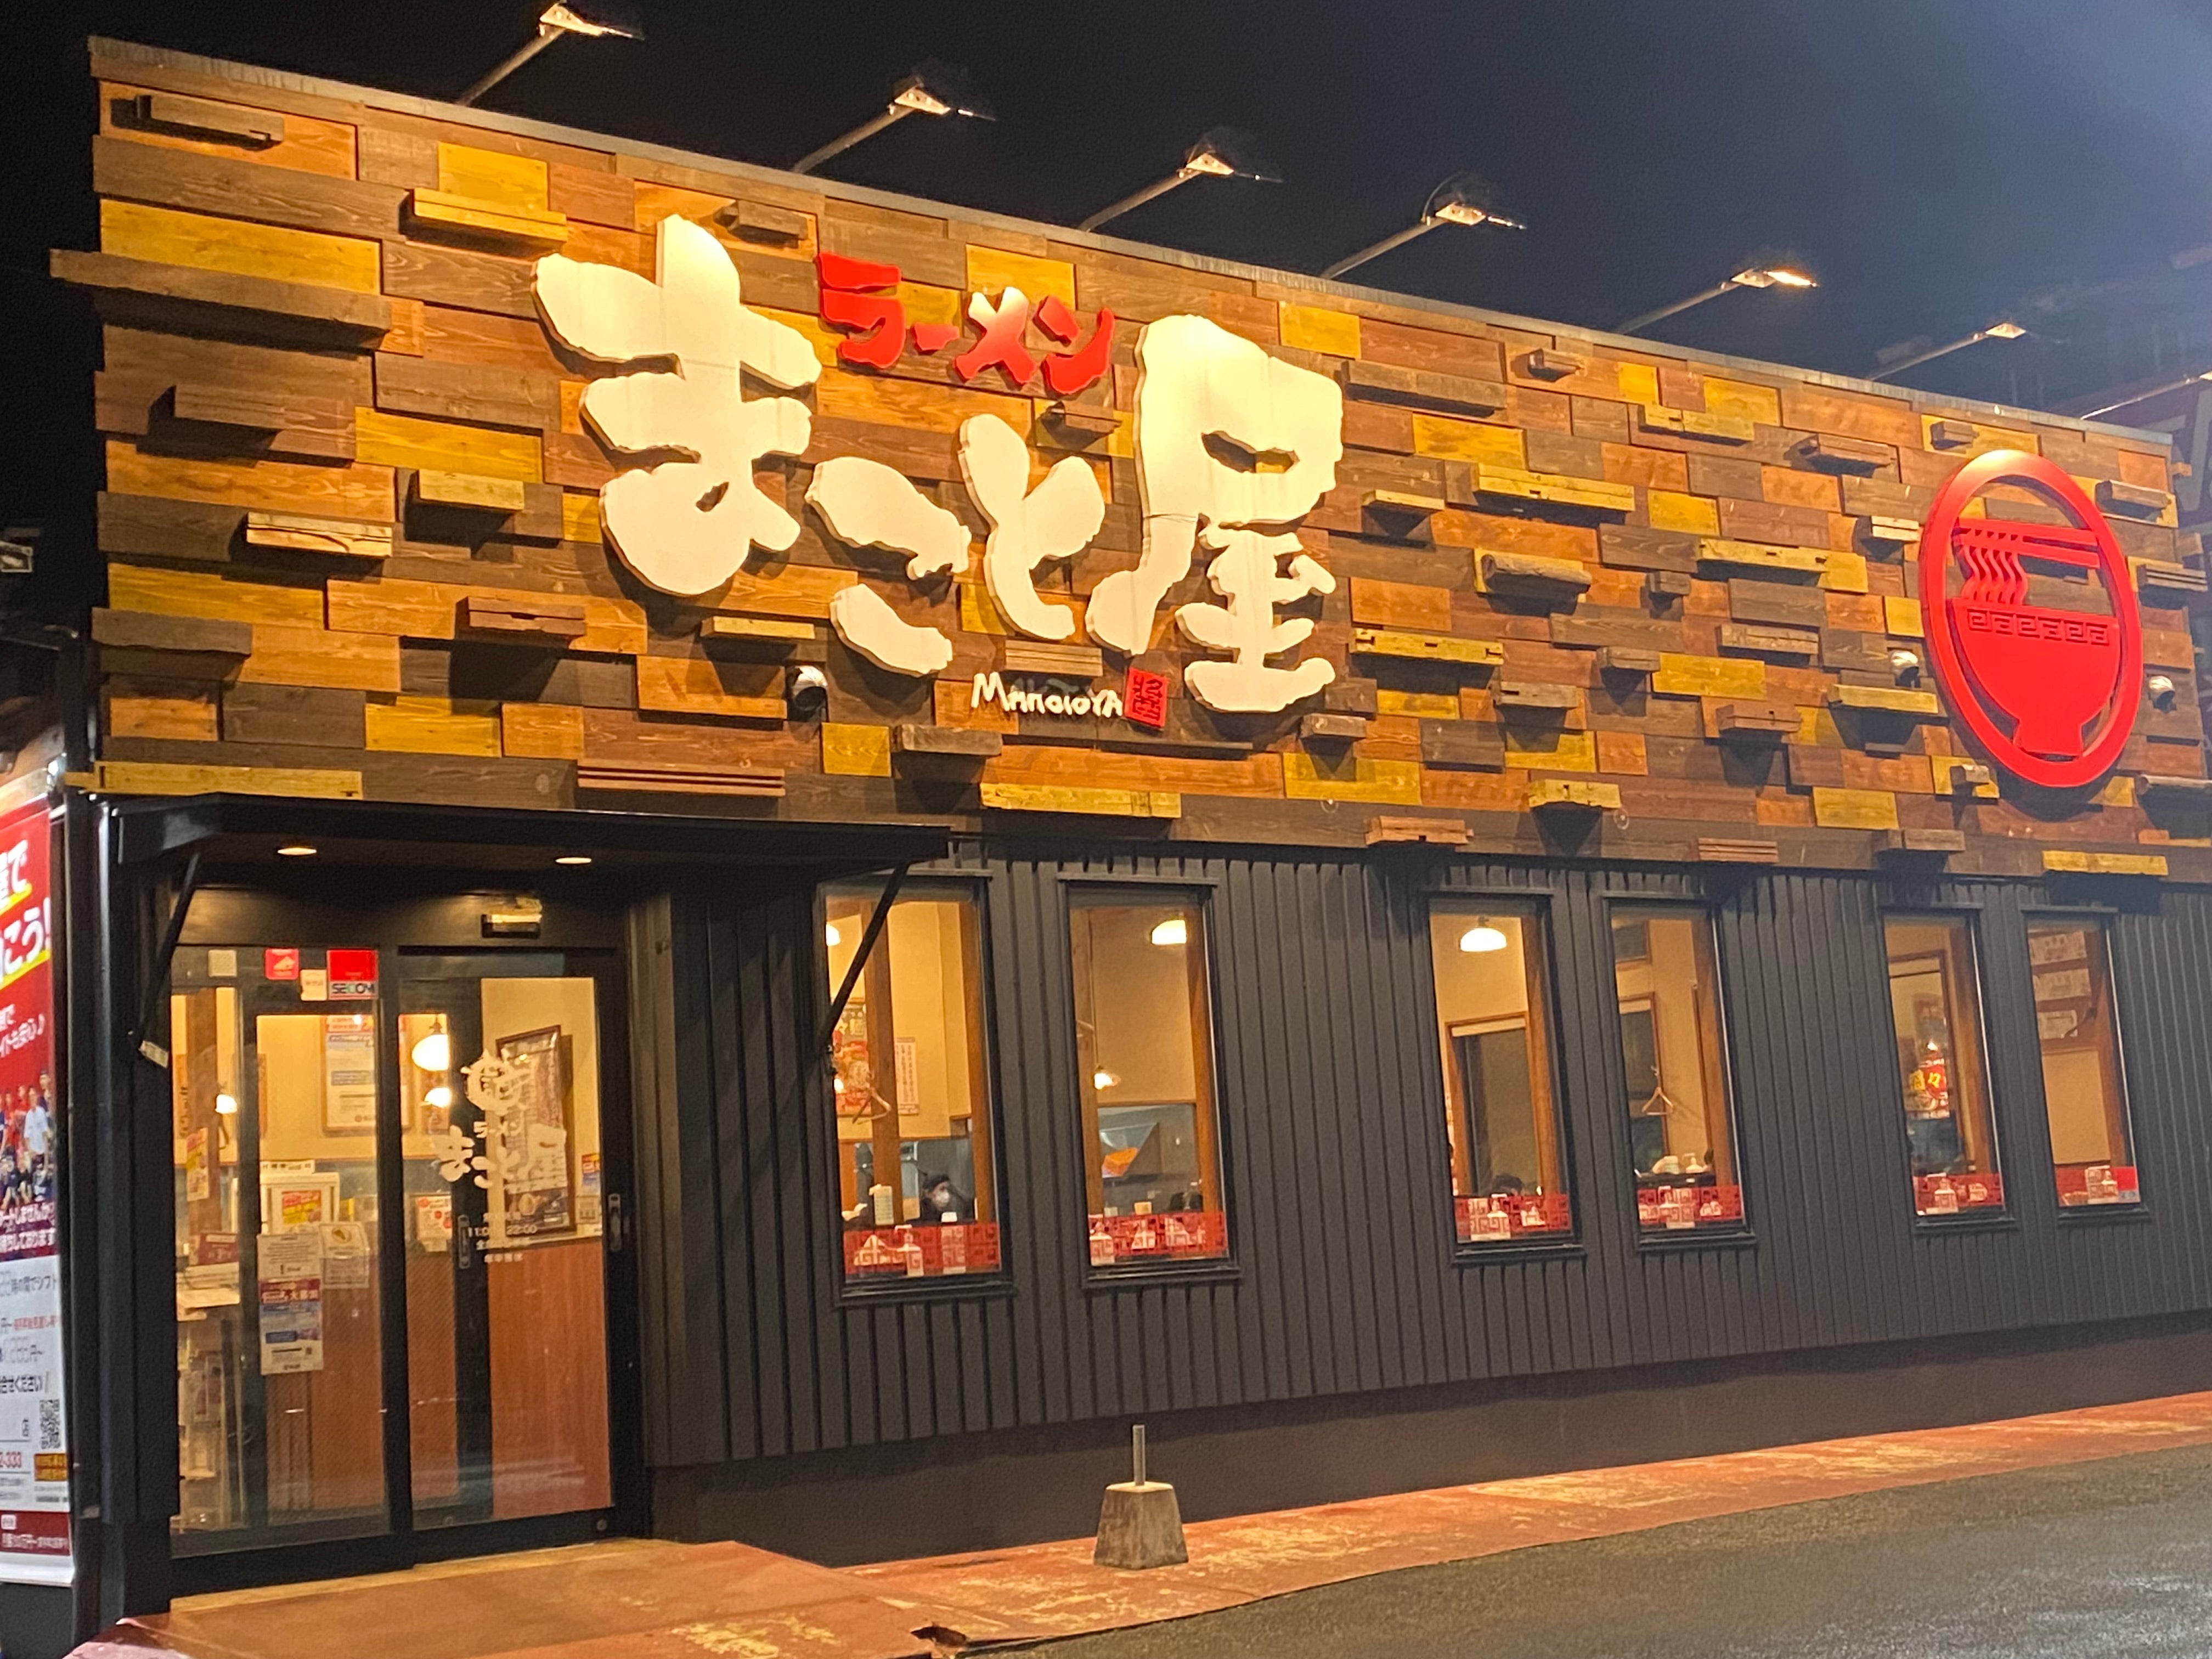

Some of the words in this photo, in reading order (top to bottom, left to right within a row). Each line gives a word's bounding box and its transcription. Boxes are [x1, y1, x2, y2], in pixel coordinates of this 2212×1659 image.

[816, 252, 1115, 396] ラーメン
[533, 213, 1342, 712] まこと屋
[332, 983, 375, 994] SECOM
